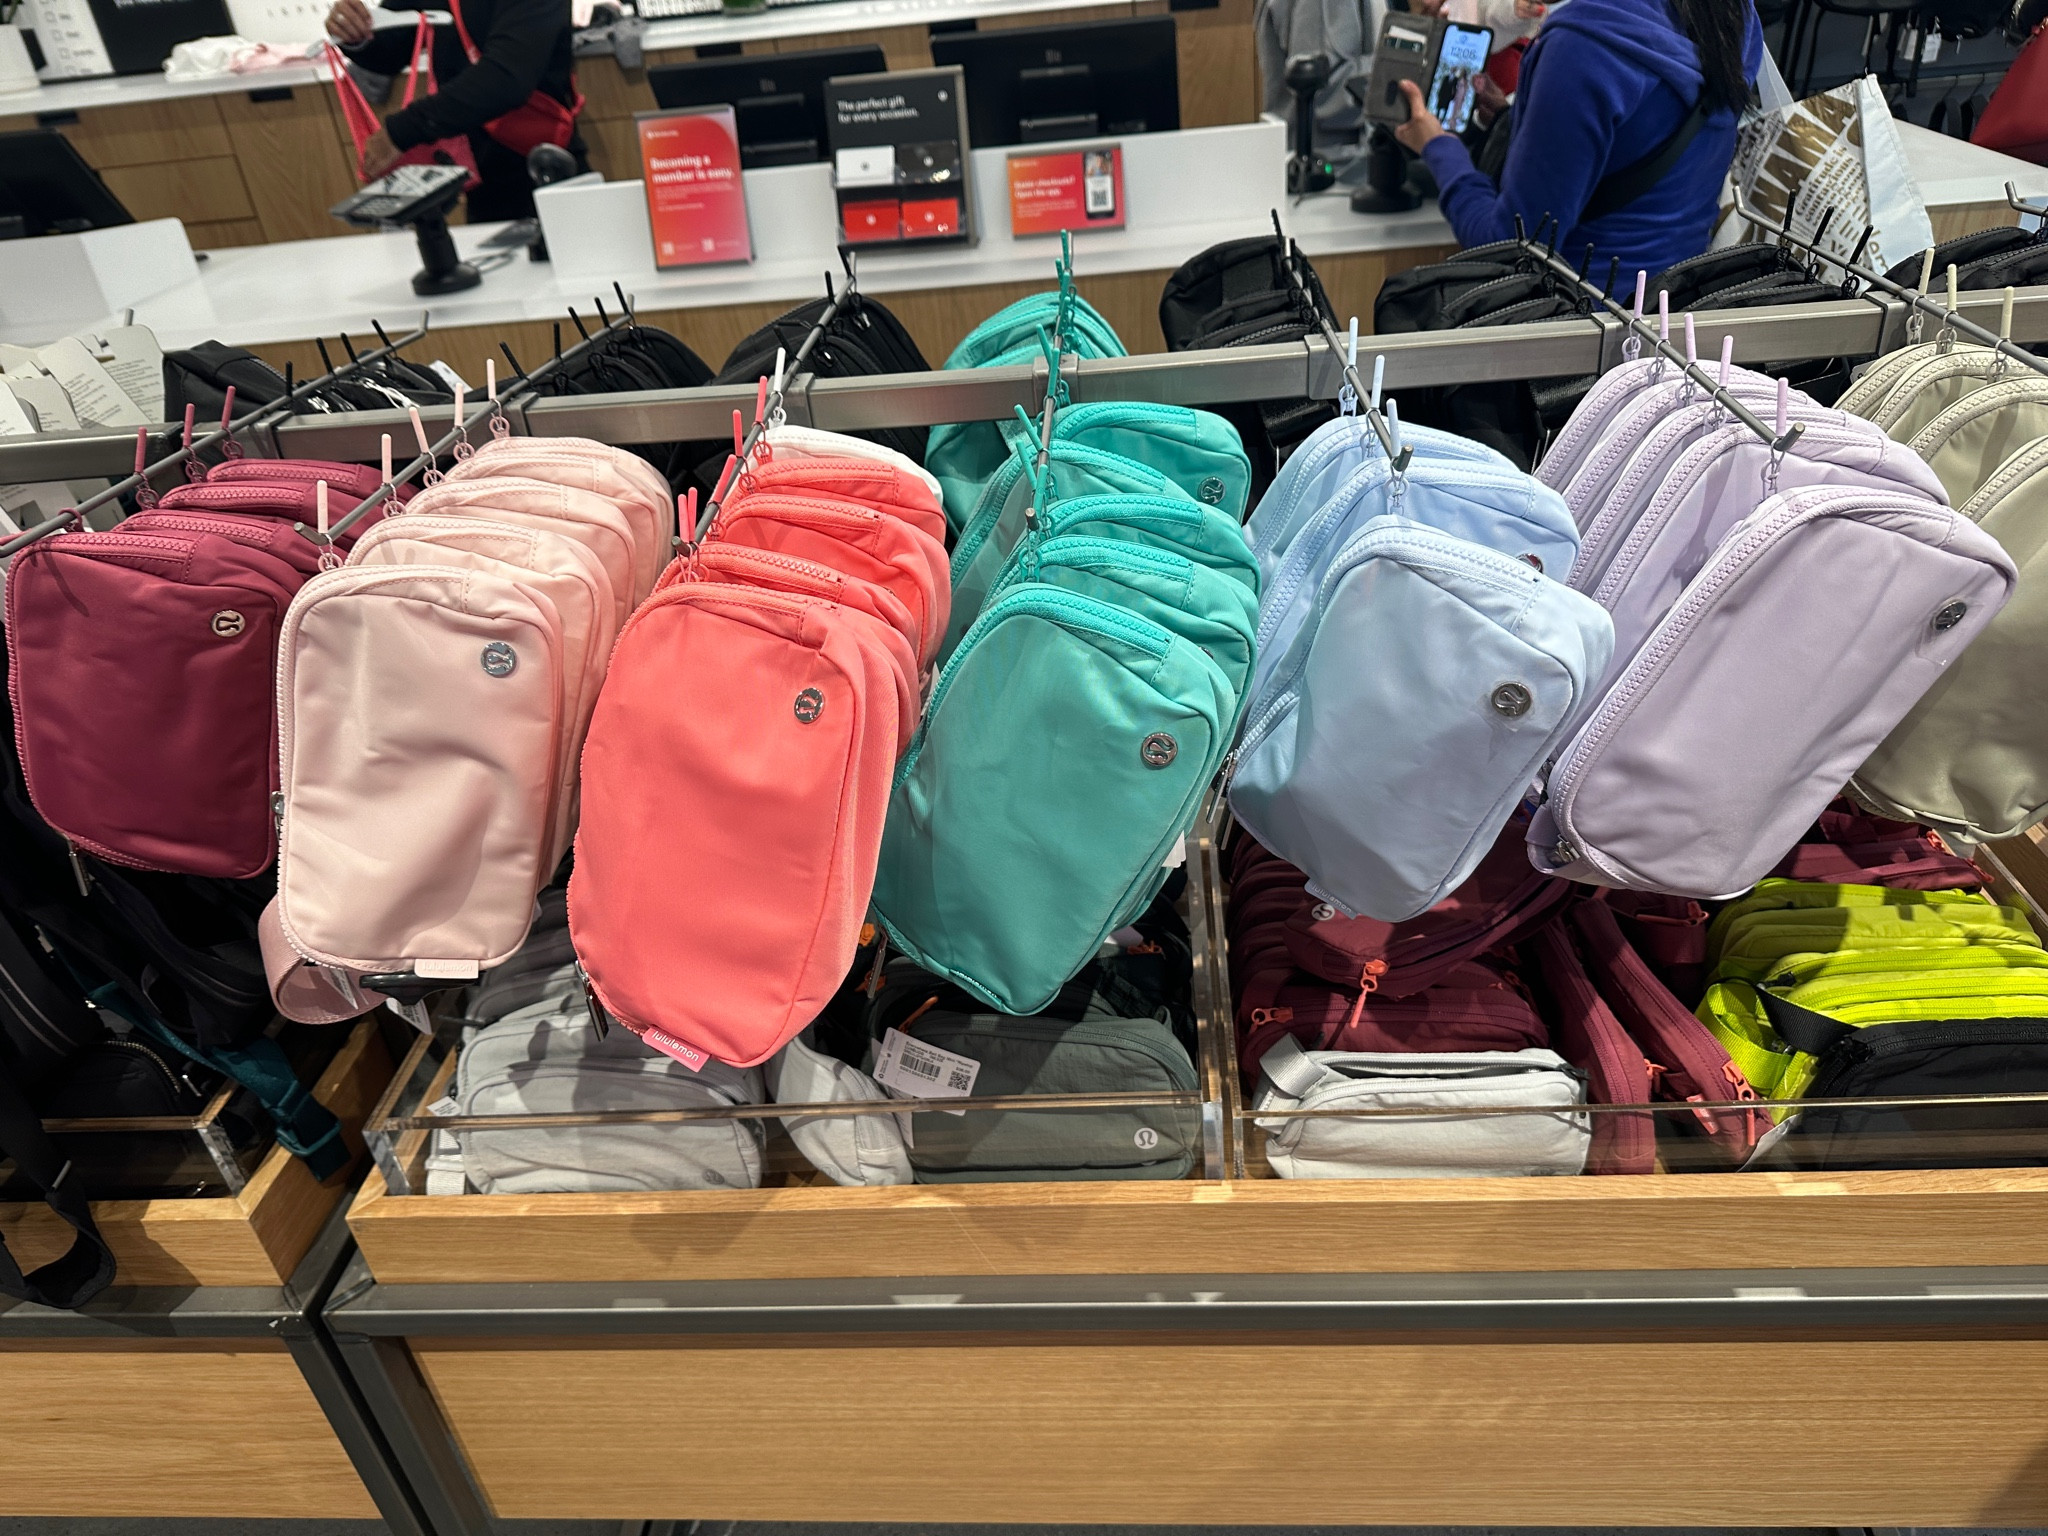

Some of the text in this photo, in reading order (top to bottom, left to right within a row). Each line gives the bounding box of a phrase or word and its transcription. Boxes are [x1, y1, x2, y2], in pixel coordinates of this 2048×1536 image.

[837, 95, 906, 112] The perfect gift
[838, 107, 920, 124] for every occasion.
[650, 154, 712, 170] Becoming a
[652, 169, 695, 184] member
[695, 168, 706, 180] is
[1795, 156, 1839, 216] Gratitude
[1833, 146, 1848, 158] is
[1805, 157, 1854, 222] contagious
[1311, 883, 1353, 913] lululemon
[421, 961, 473, 973] lululemon
[651, 1030, 700, 1062] lululemon
